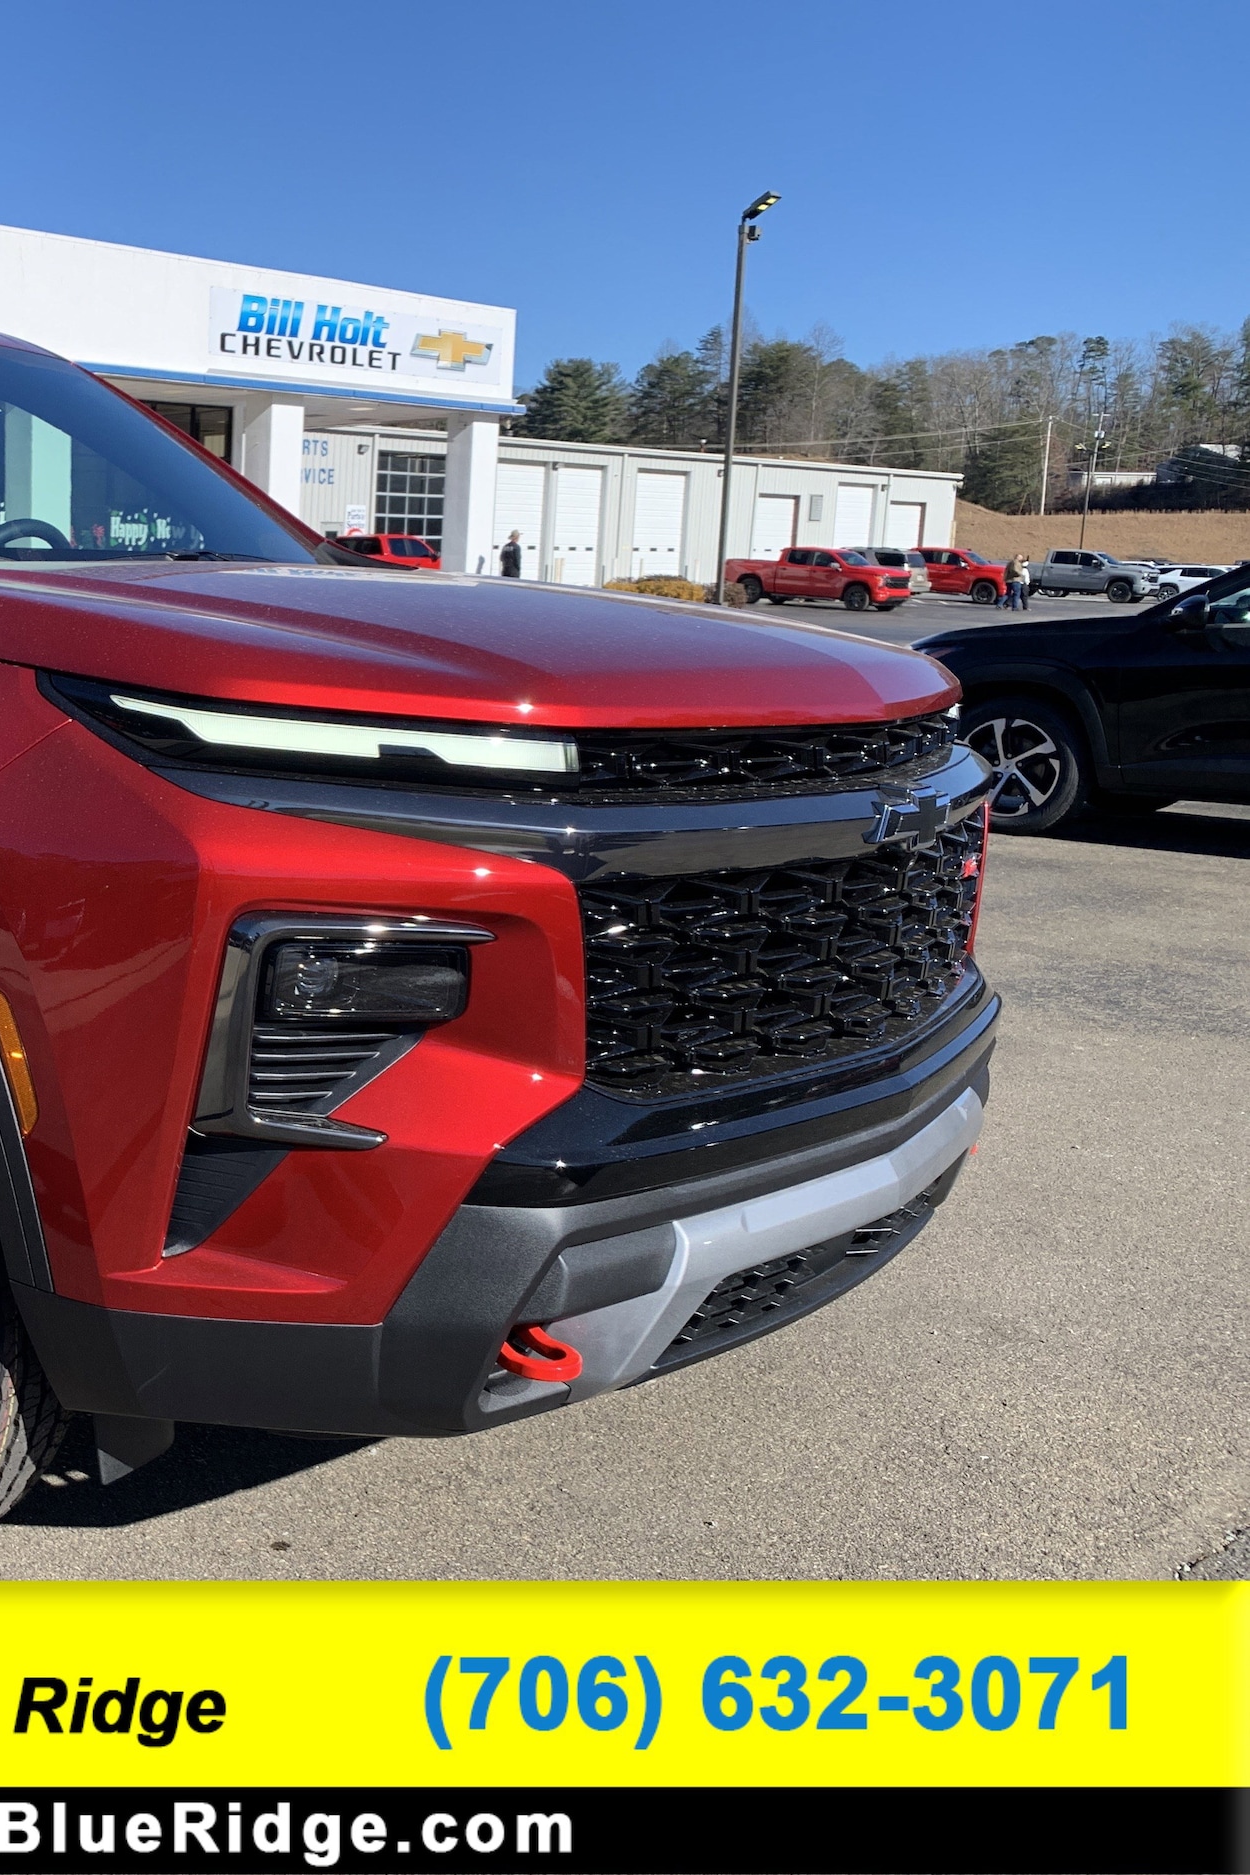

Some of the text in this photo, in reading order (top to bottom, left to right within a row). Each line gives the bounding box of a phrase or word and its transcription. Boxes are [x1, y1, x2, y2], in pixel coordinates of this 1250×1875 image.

[236, 294, 390, 348] Bill Holt
[220, 332, 402, 371] CHEVROLET
[301, 467, 335, 485] VICE
[110, 516, 149, 546] Happy
